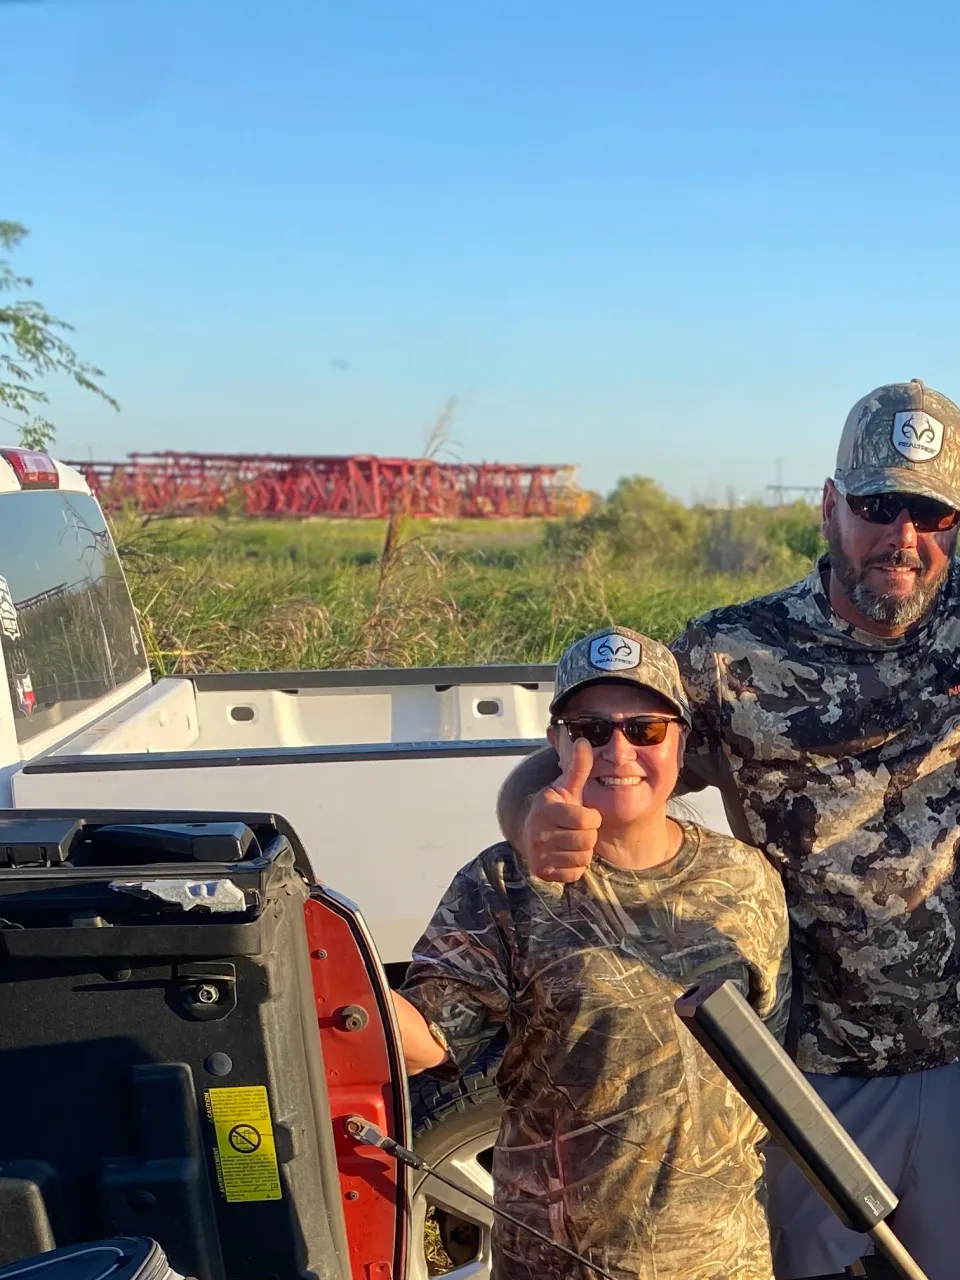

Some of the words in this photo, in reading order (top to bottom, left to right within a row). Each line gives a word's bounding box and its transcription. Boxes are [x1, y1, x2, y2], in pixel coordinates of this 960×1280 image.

[897, 441, 936, 455] REALTREE
[595, 657, 635, 665] REALTREE
[203, 1092, 214, 1119] CAUTION
